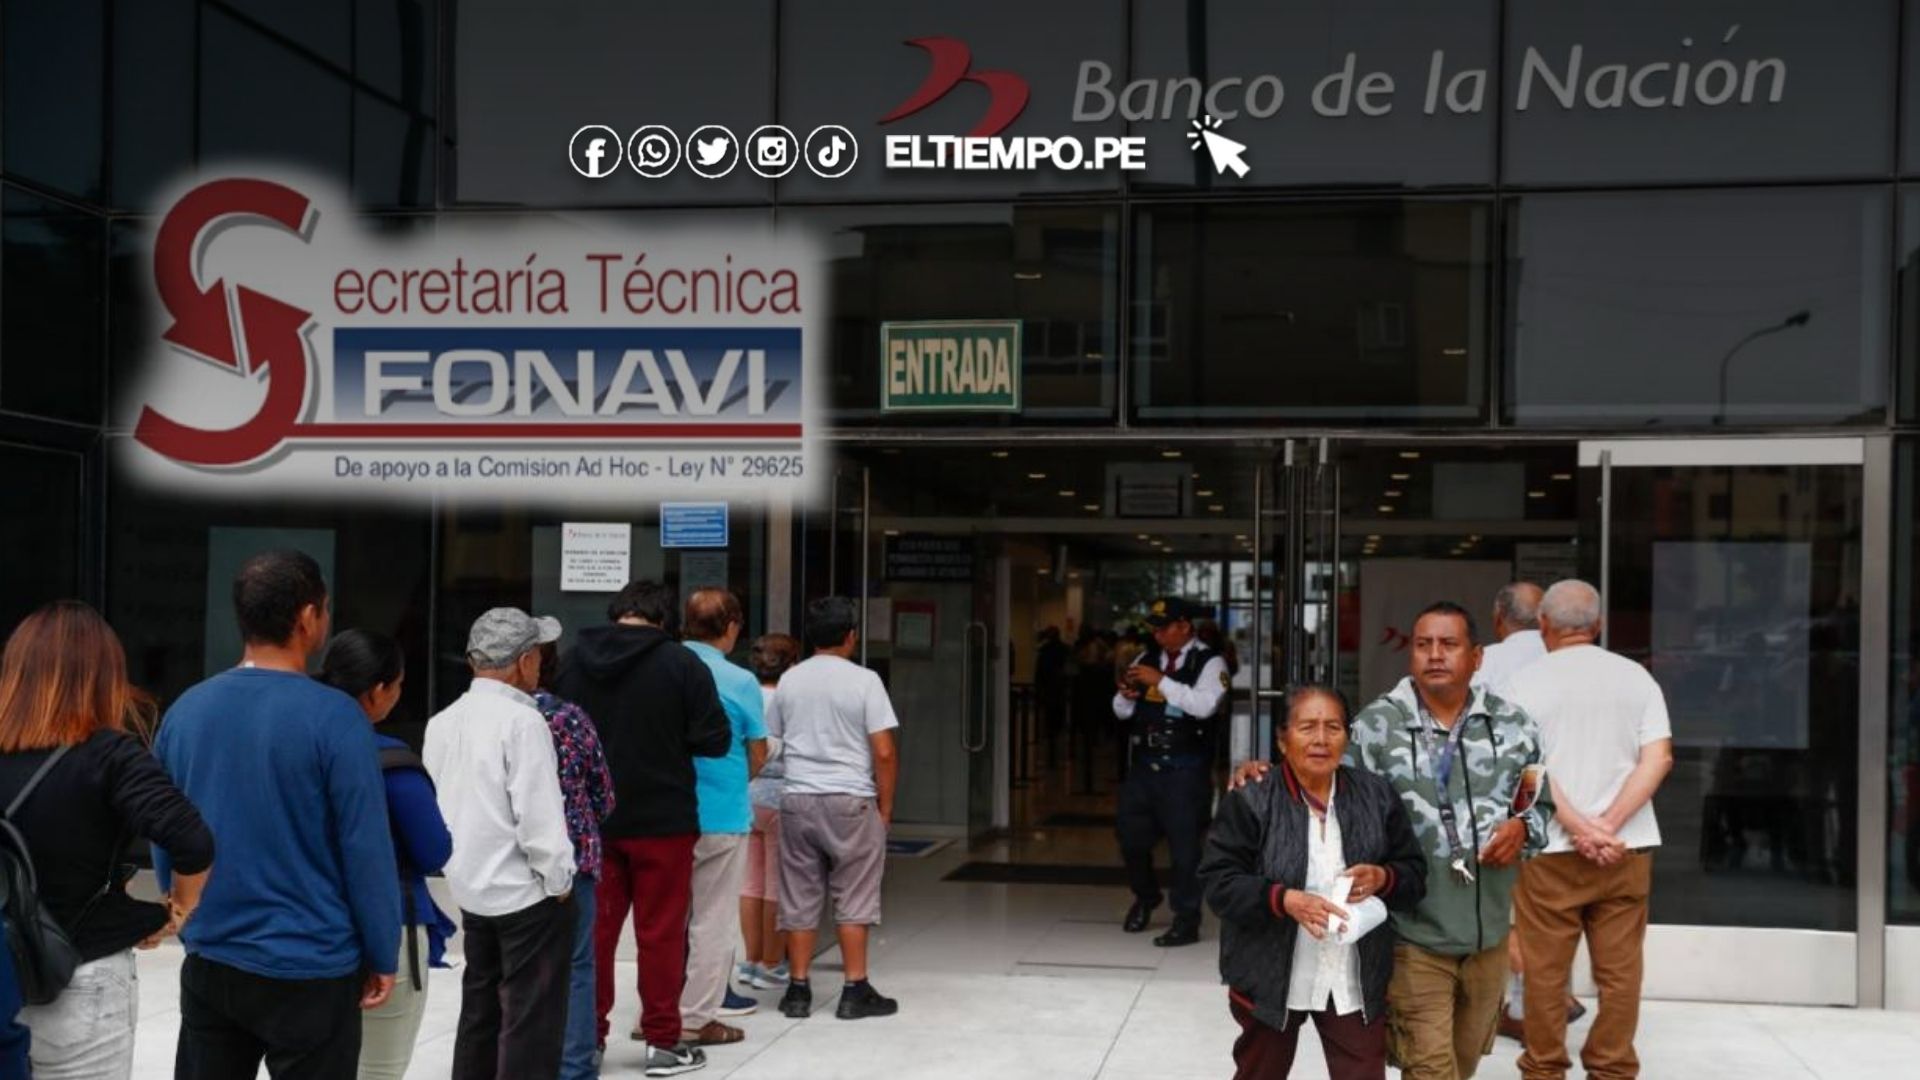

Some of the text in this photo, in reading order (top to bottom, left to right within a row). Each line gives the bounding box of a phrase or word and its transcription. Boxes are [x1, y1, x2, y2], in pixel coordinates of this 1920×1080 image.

[1072, 28, 1786, 122] Banco de la Nación
[890, 338, 1011, 395] ENTRADA
